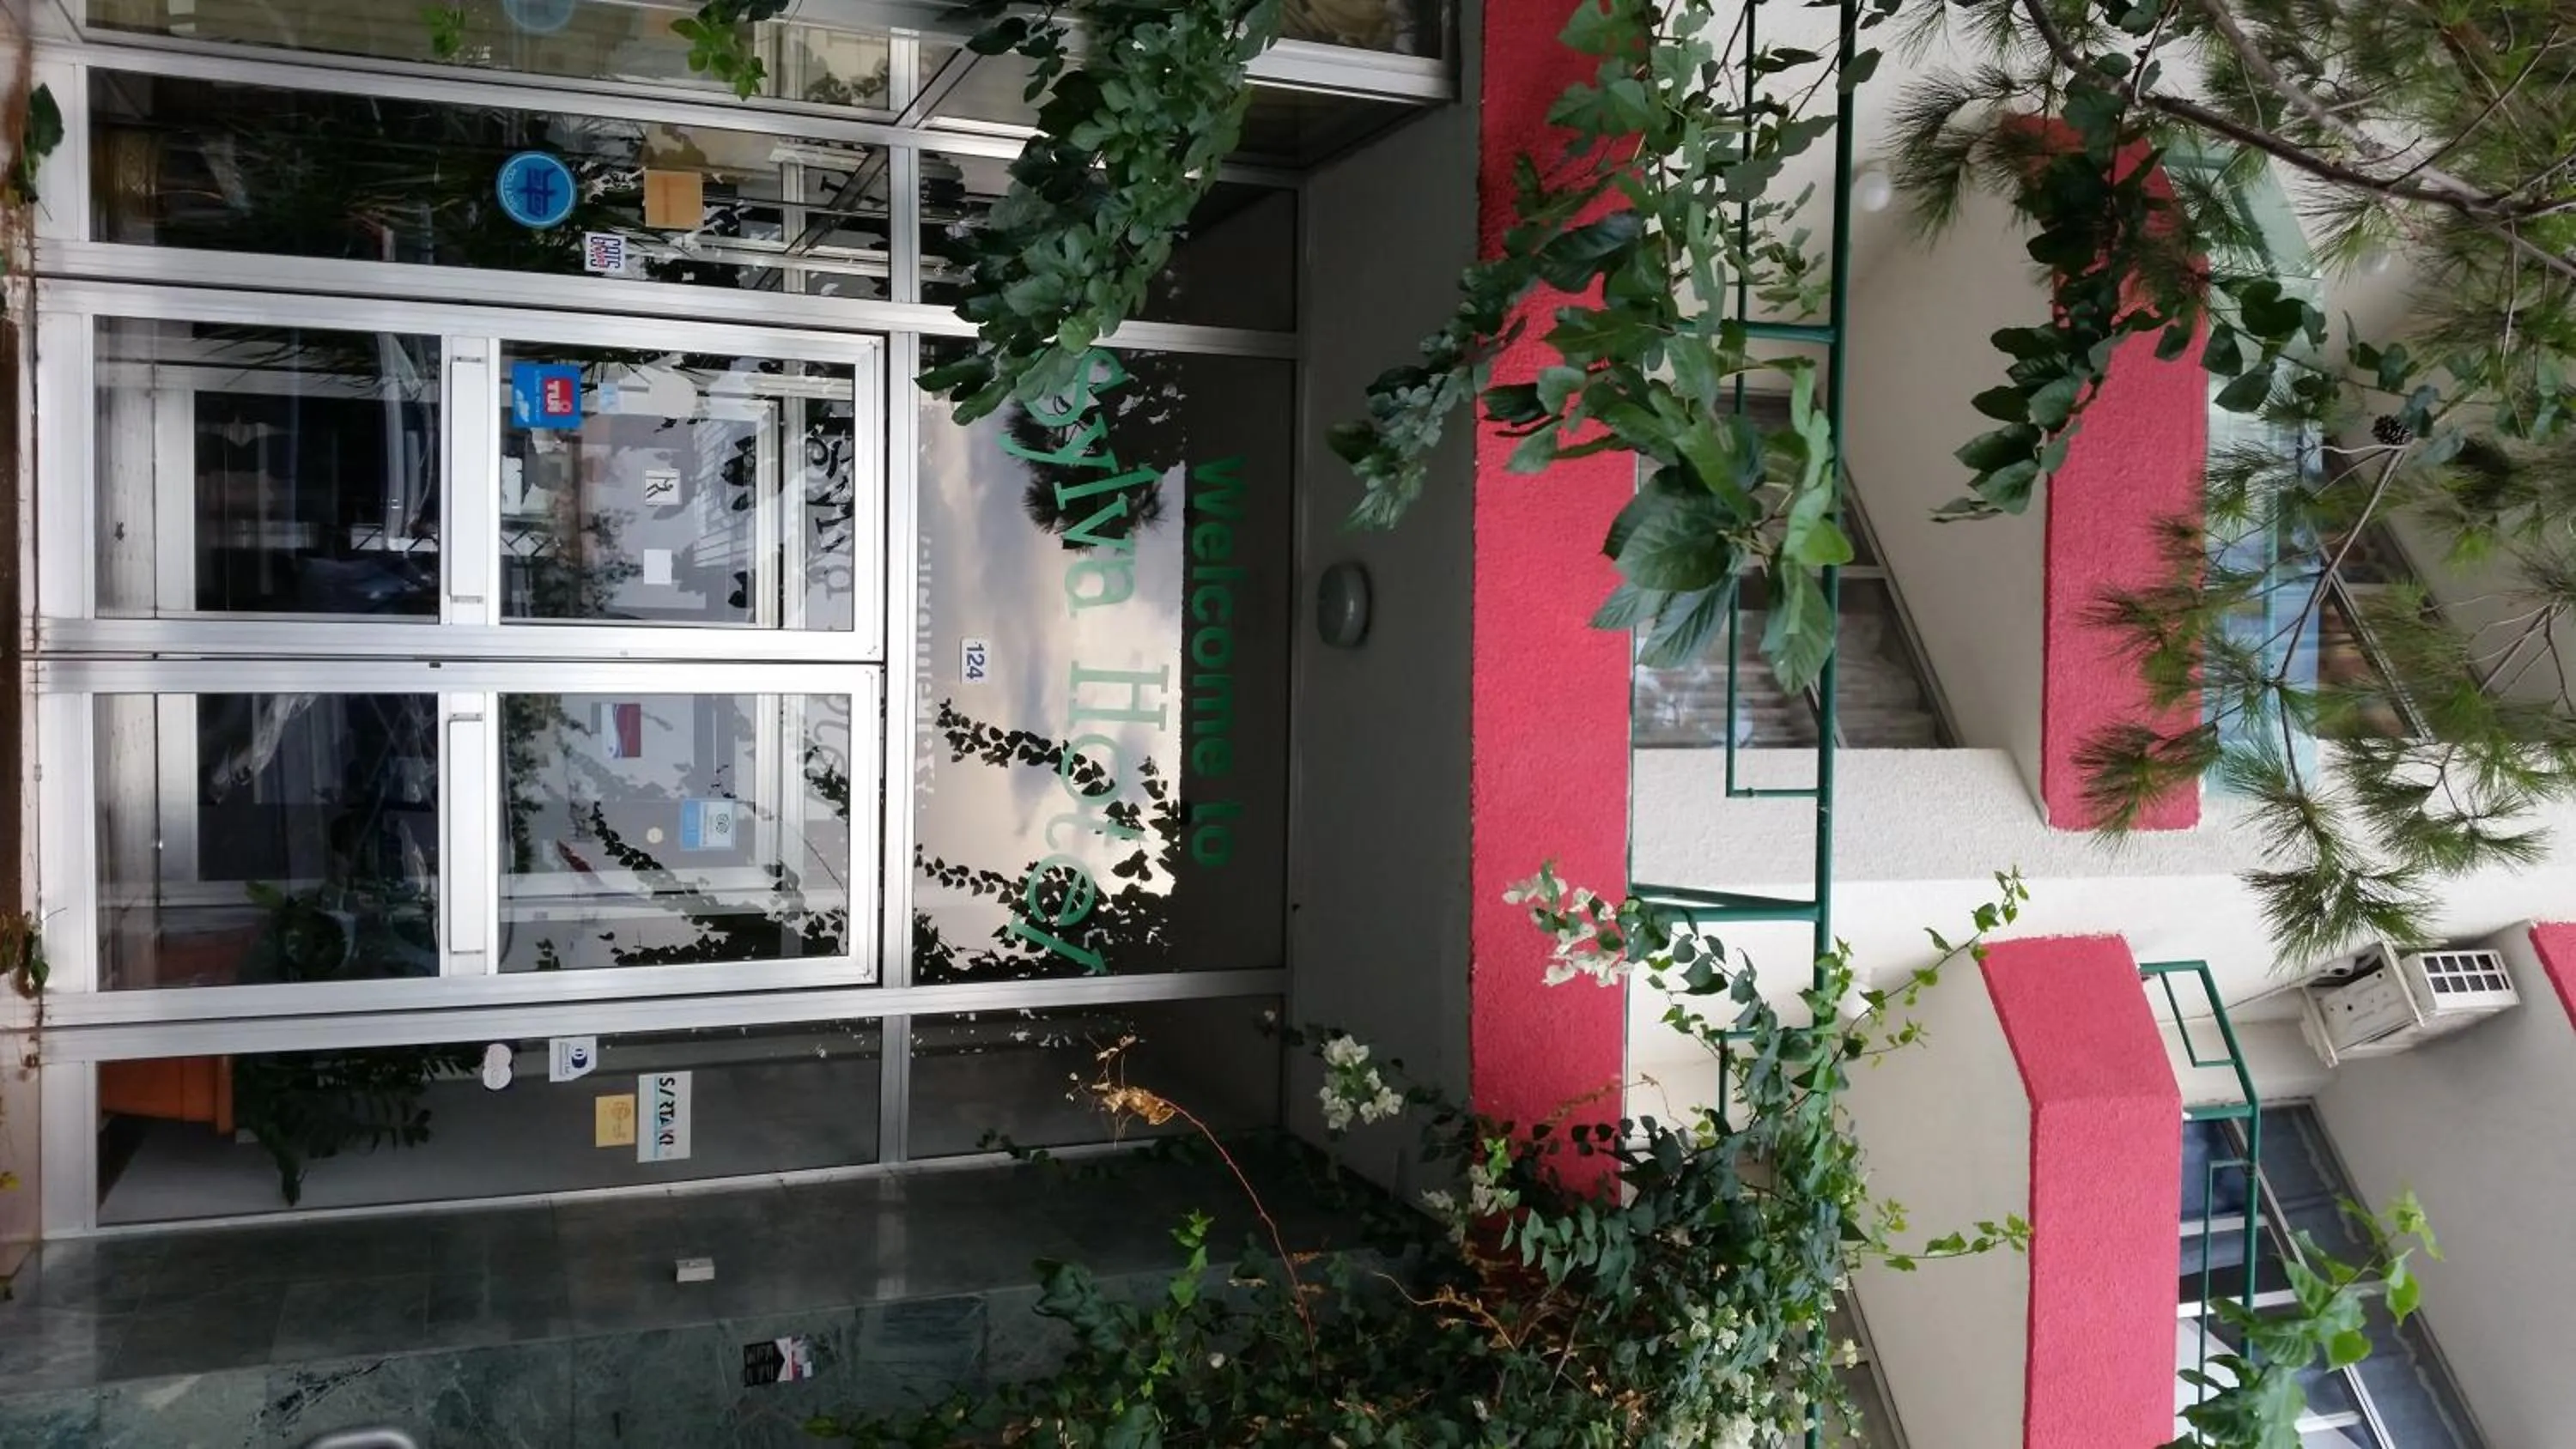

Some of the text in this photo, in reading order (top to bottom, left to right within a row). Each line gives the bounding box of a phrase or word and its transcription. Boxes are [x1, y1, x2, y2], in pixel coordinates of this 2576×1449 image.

[546, 379, 573, 413] TUI
[966, 643, 985, 680] 124
[994, 346, 1170, 974] Sylva Hotel
[1191, 456, 1248, 869] Welcome to
